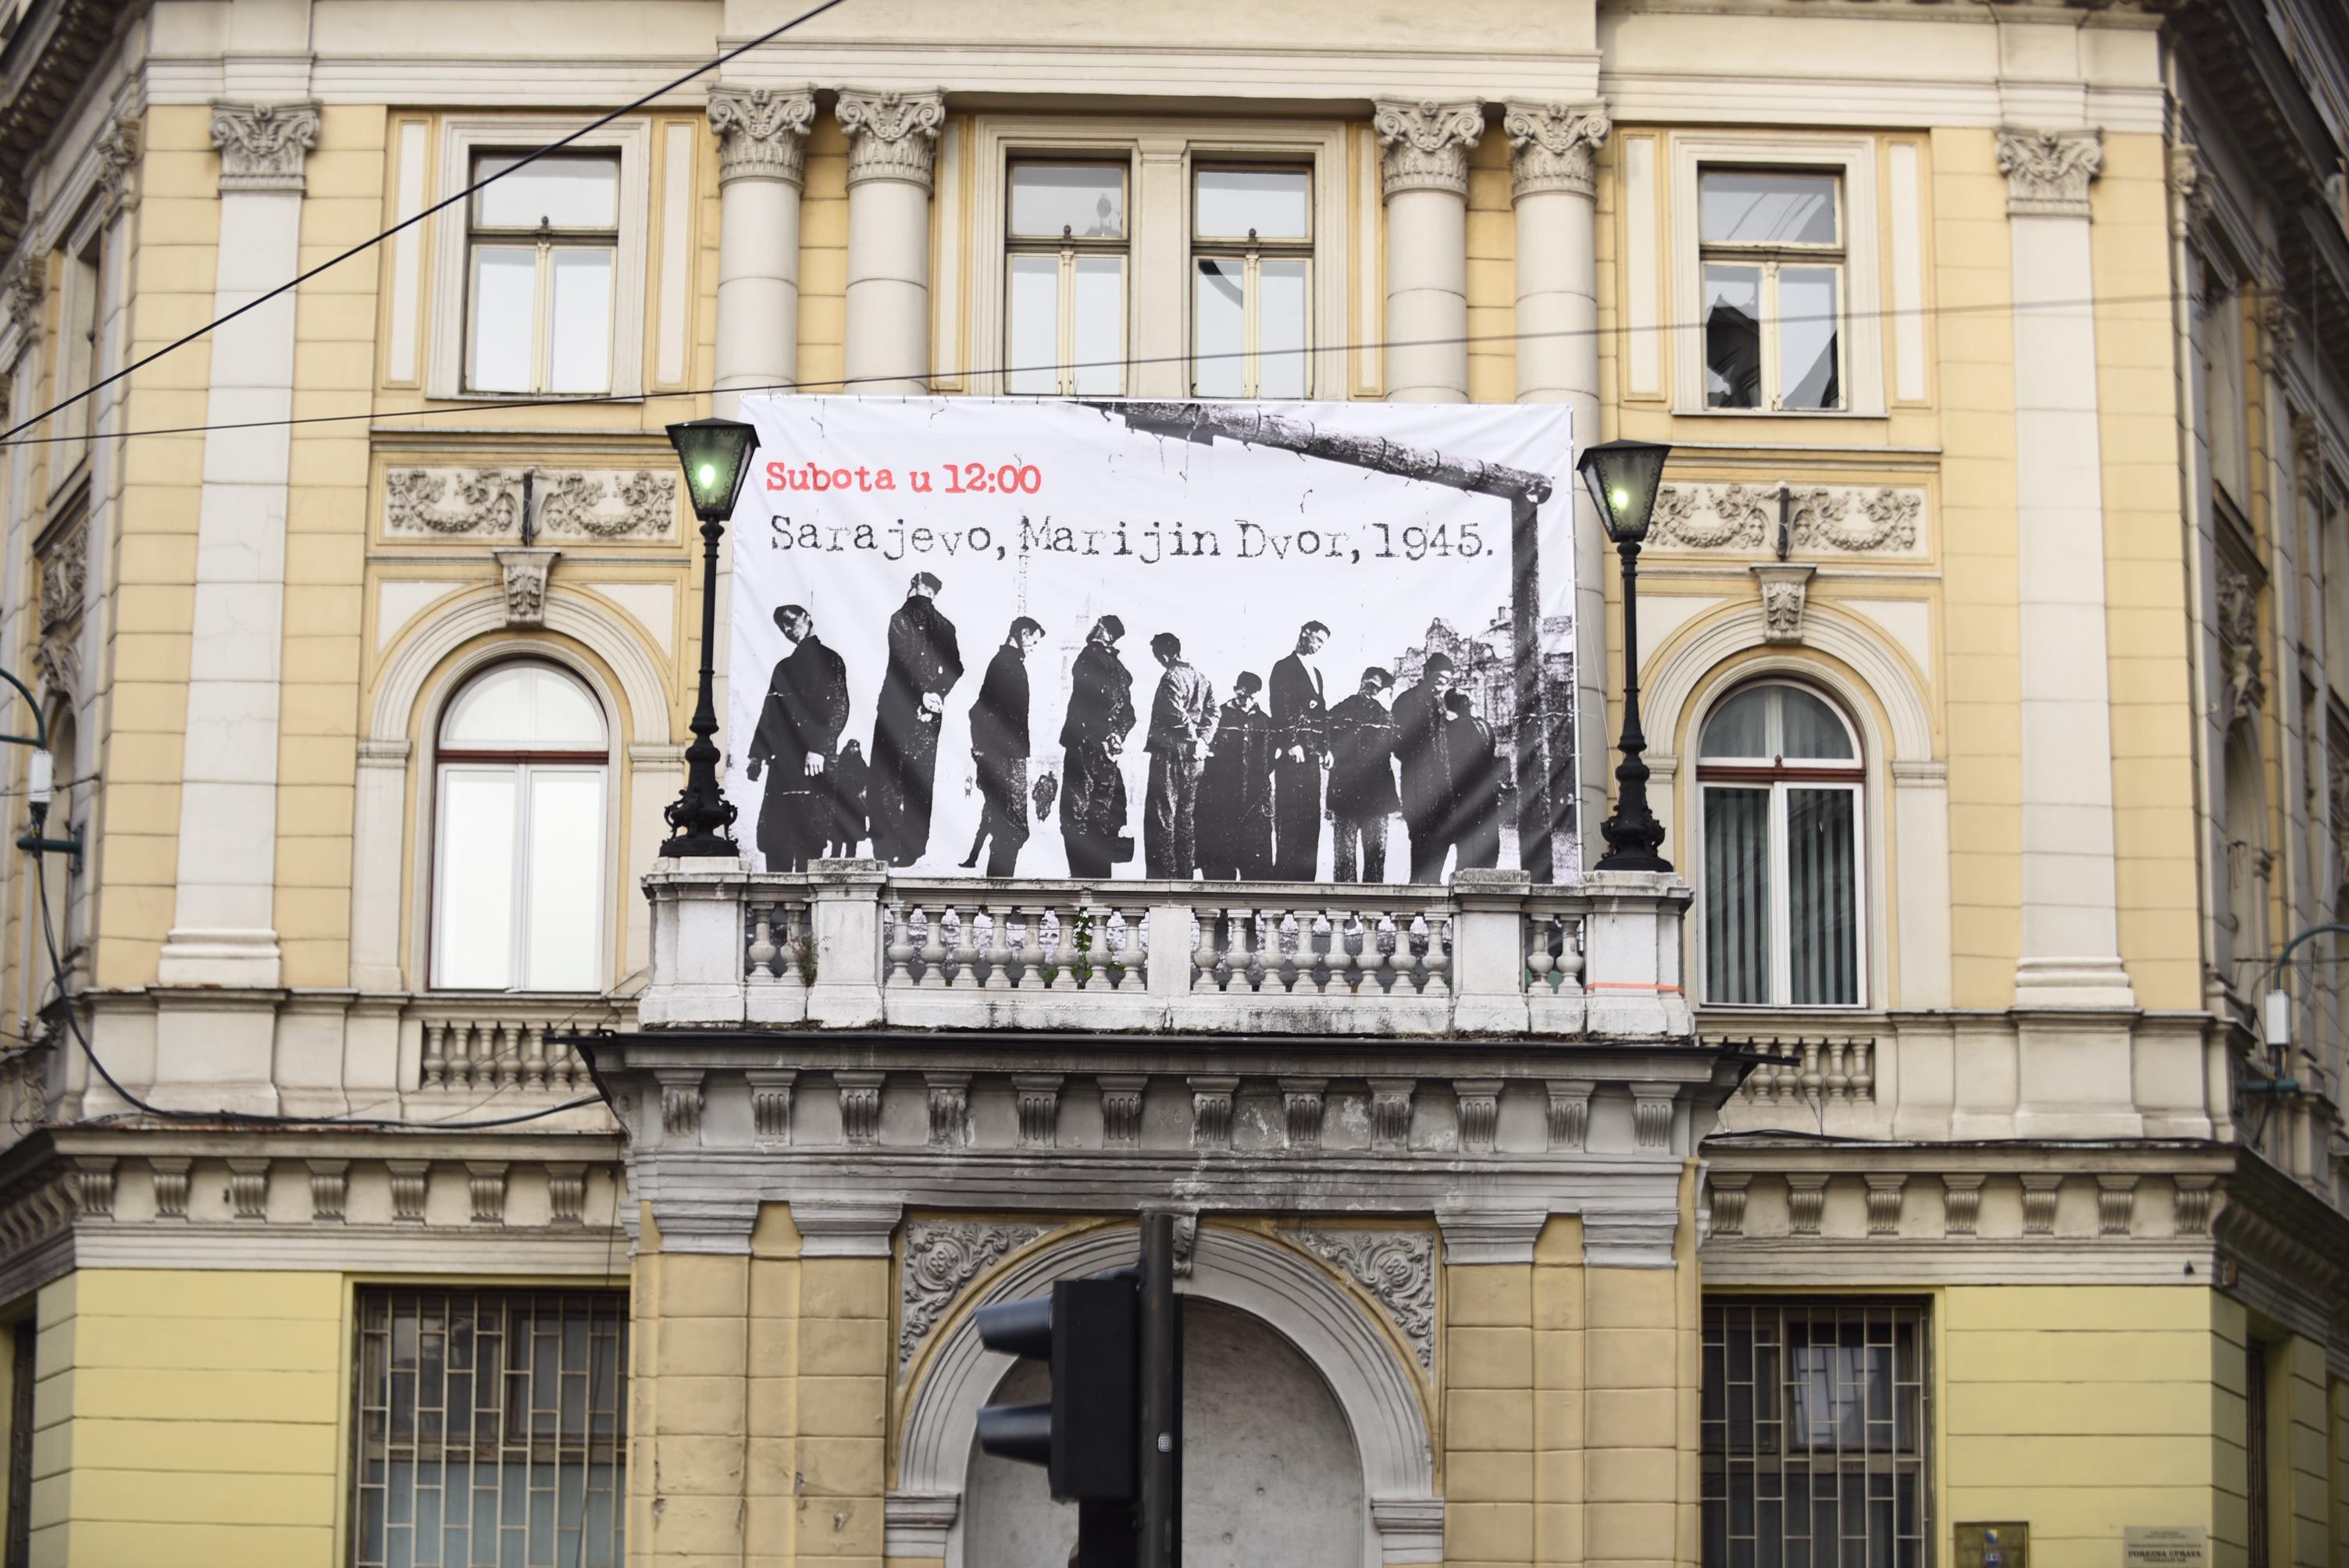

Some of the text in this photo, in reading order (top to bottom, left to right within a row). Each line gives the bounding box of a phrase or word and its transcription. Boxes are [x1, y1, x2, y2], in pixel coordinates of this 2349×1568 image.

[766, 461, 1042, 495] Subota u 12:00
[771, 515, 1493, 565] Sarajevo, Marijin Dvor, 1945.
